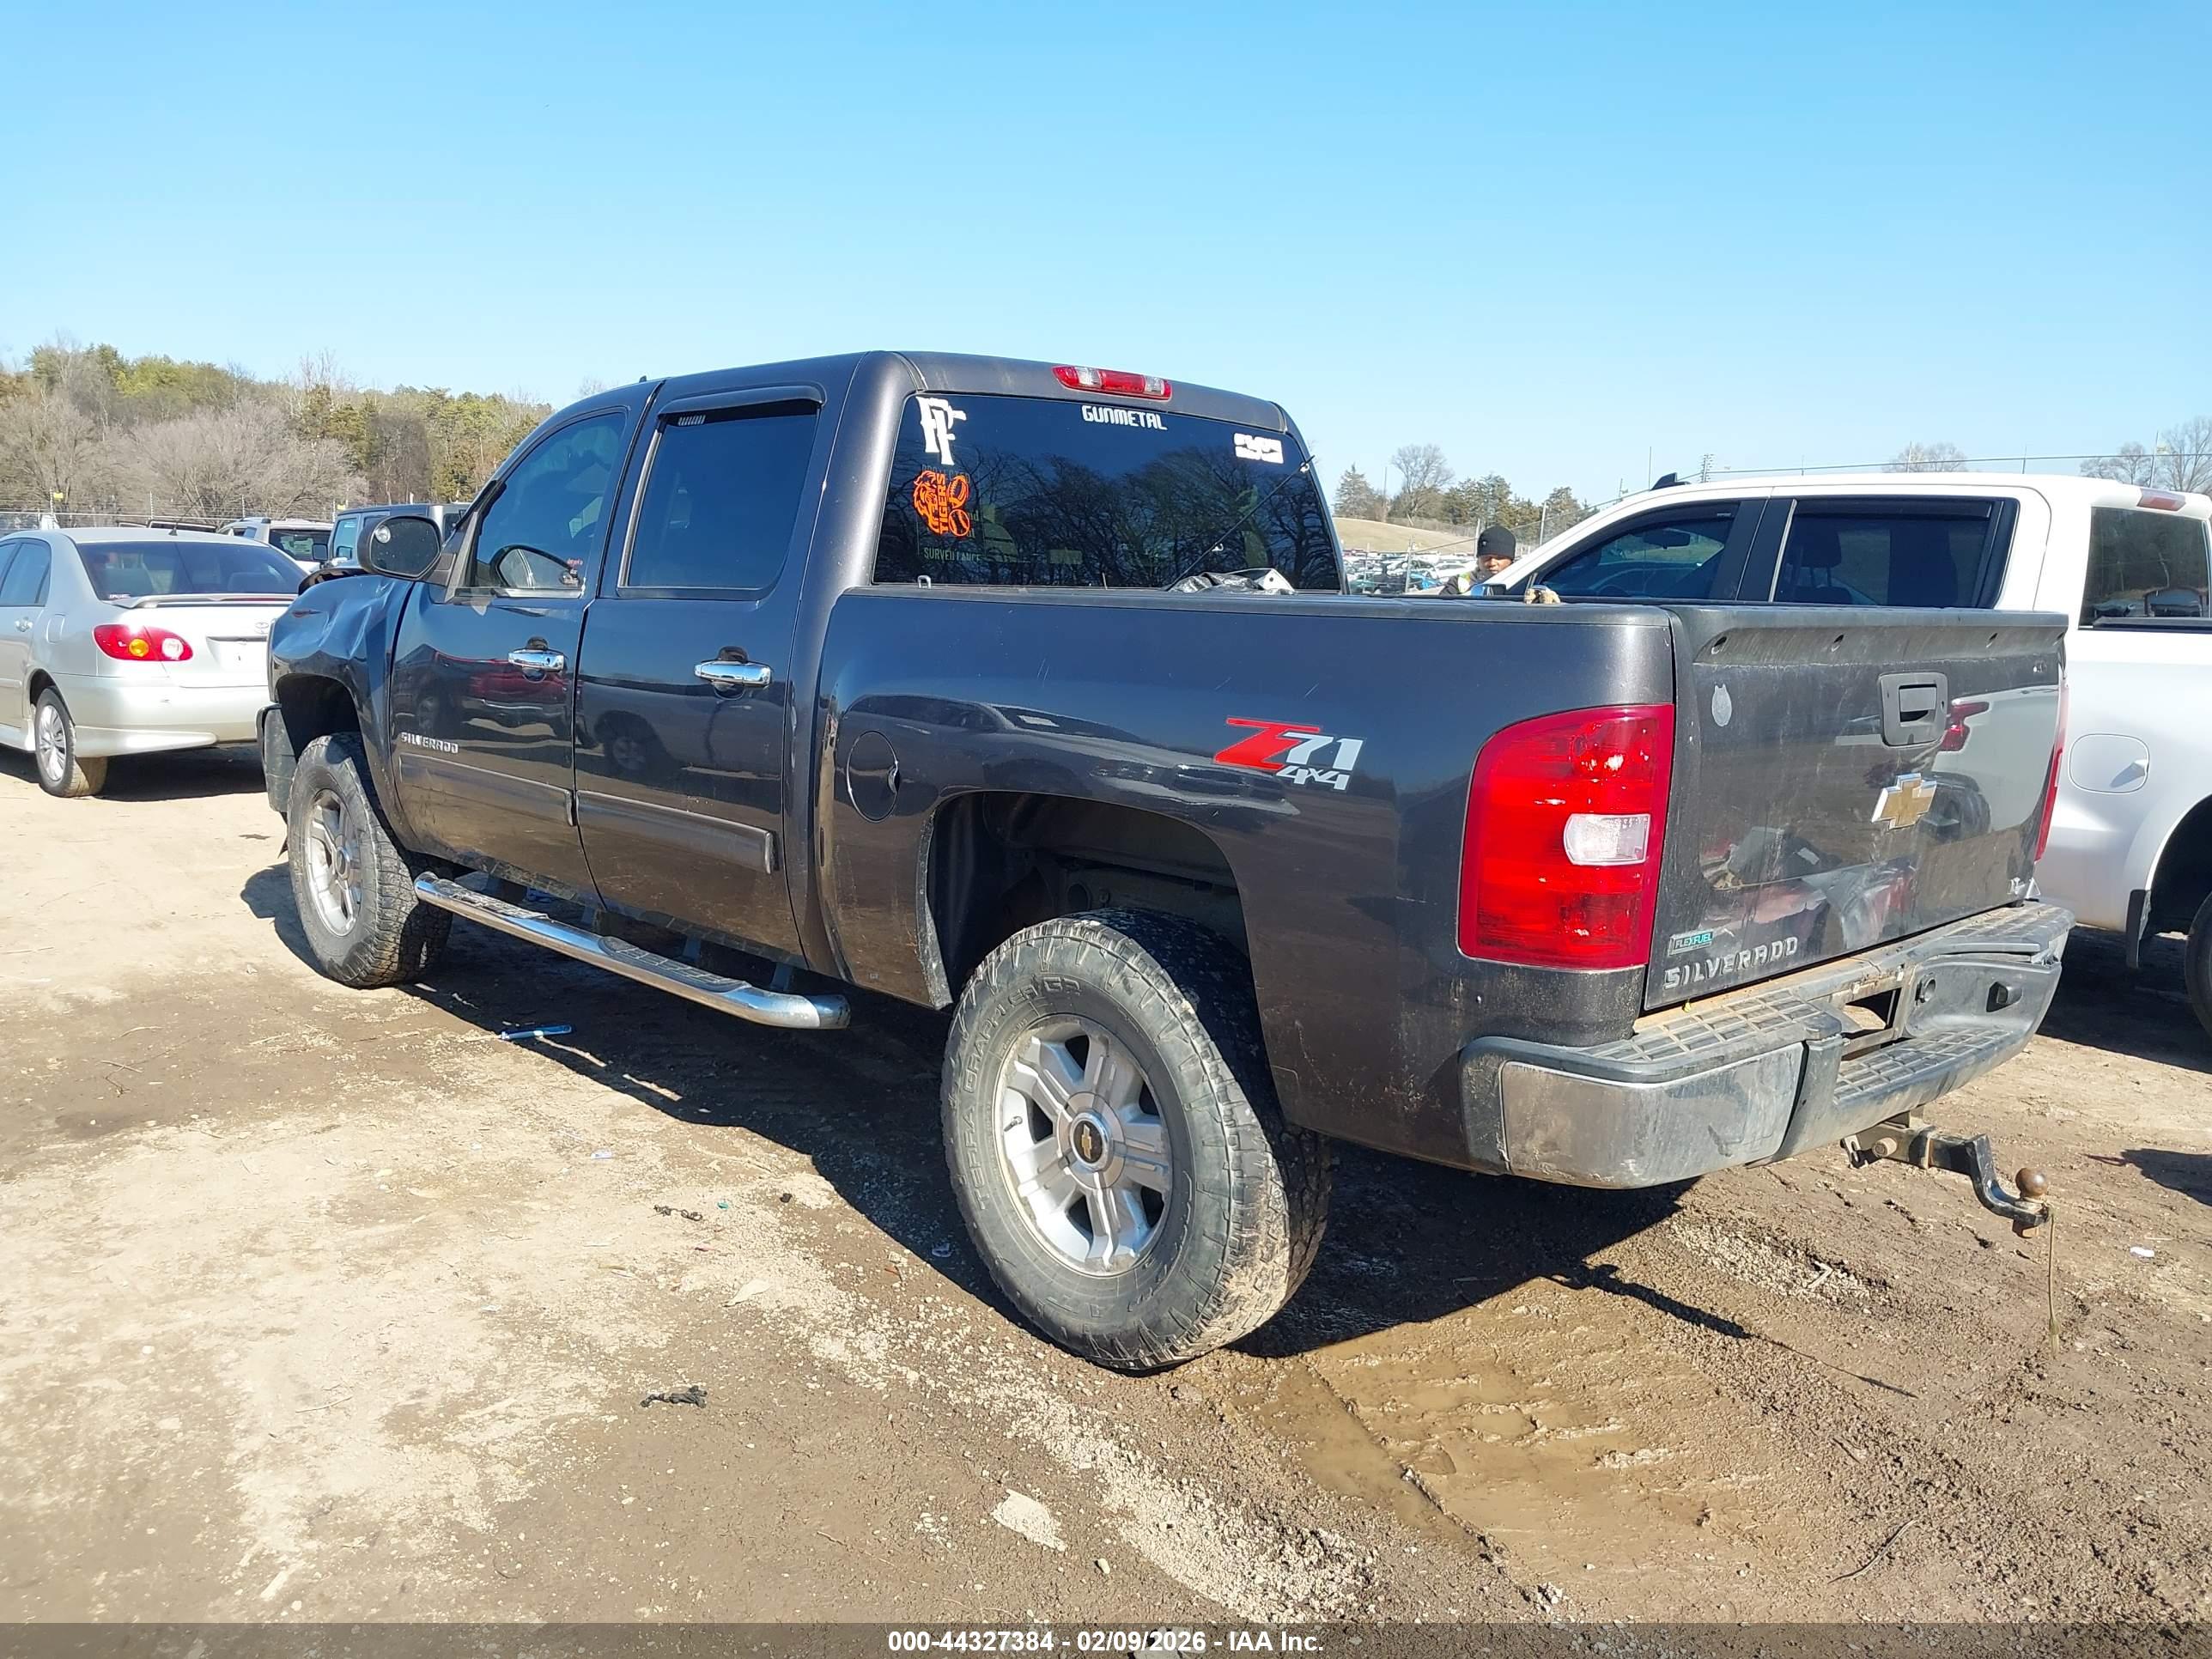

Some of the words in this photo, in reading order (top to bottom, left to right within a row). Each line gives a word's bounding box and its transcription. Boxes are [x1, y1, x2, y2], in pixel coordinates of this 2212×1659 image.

[1082, 404, 1168, 430] GUNMETAL
[937, 473, 948, 534] TIGERS
[401, 732, 459, 754] SILVERADO
[1213, 716, 1364, 772] Z71
[1674, 932, 1713, 949] FLEXFUEL
[1663, 936, 1799, 989] SILVERADO
